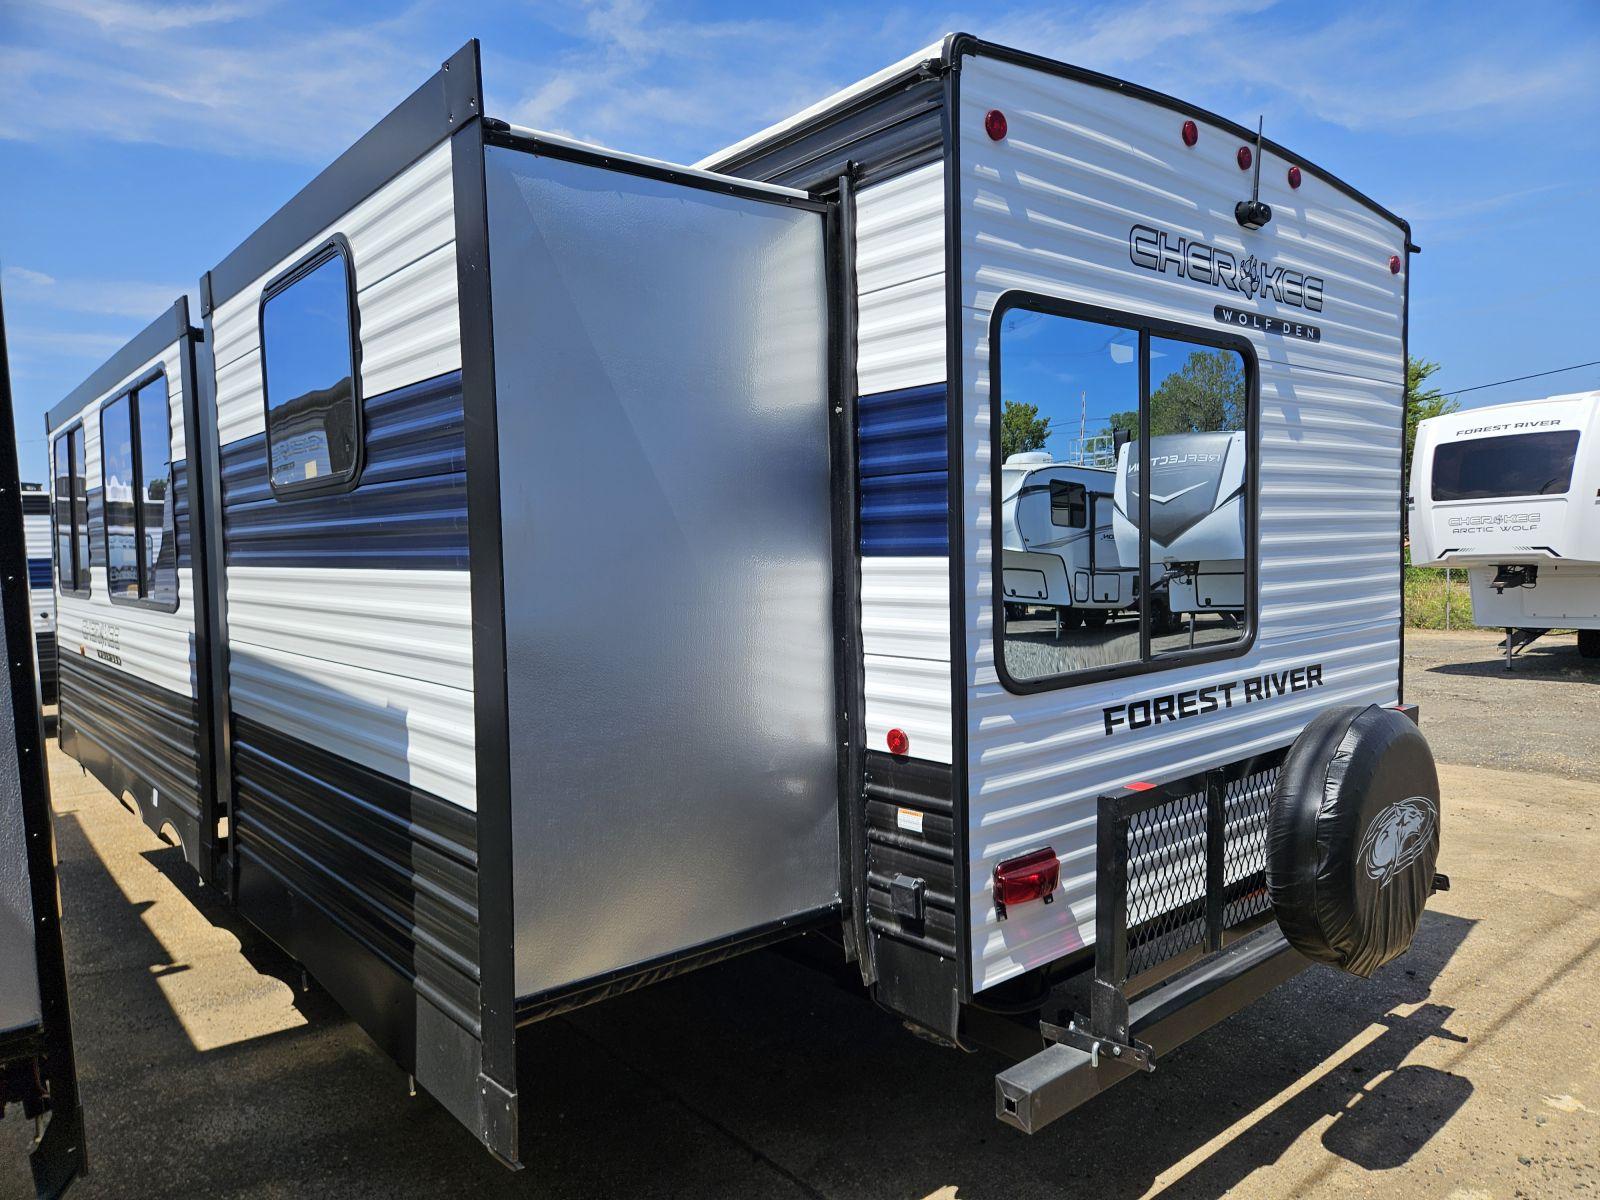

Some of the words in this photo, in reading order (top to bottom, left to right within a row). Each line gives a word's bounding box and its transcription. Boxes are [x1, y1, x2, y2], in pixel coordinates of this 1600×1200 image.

[1222, 308, 1272, 330] WOLF
[1283, 322, 1314, 339] DEN
[1456, 423, 1511, 436] FOREST
[1514, 419, 1561, 429] RIVER
[1452, 526, 1494, 534] ARCTIC
[1500, 524, 1538, 532] WOLF
[1102, 681, 1237, 736] FOREST
[1243, 663, 1324, 704] RIVER
